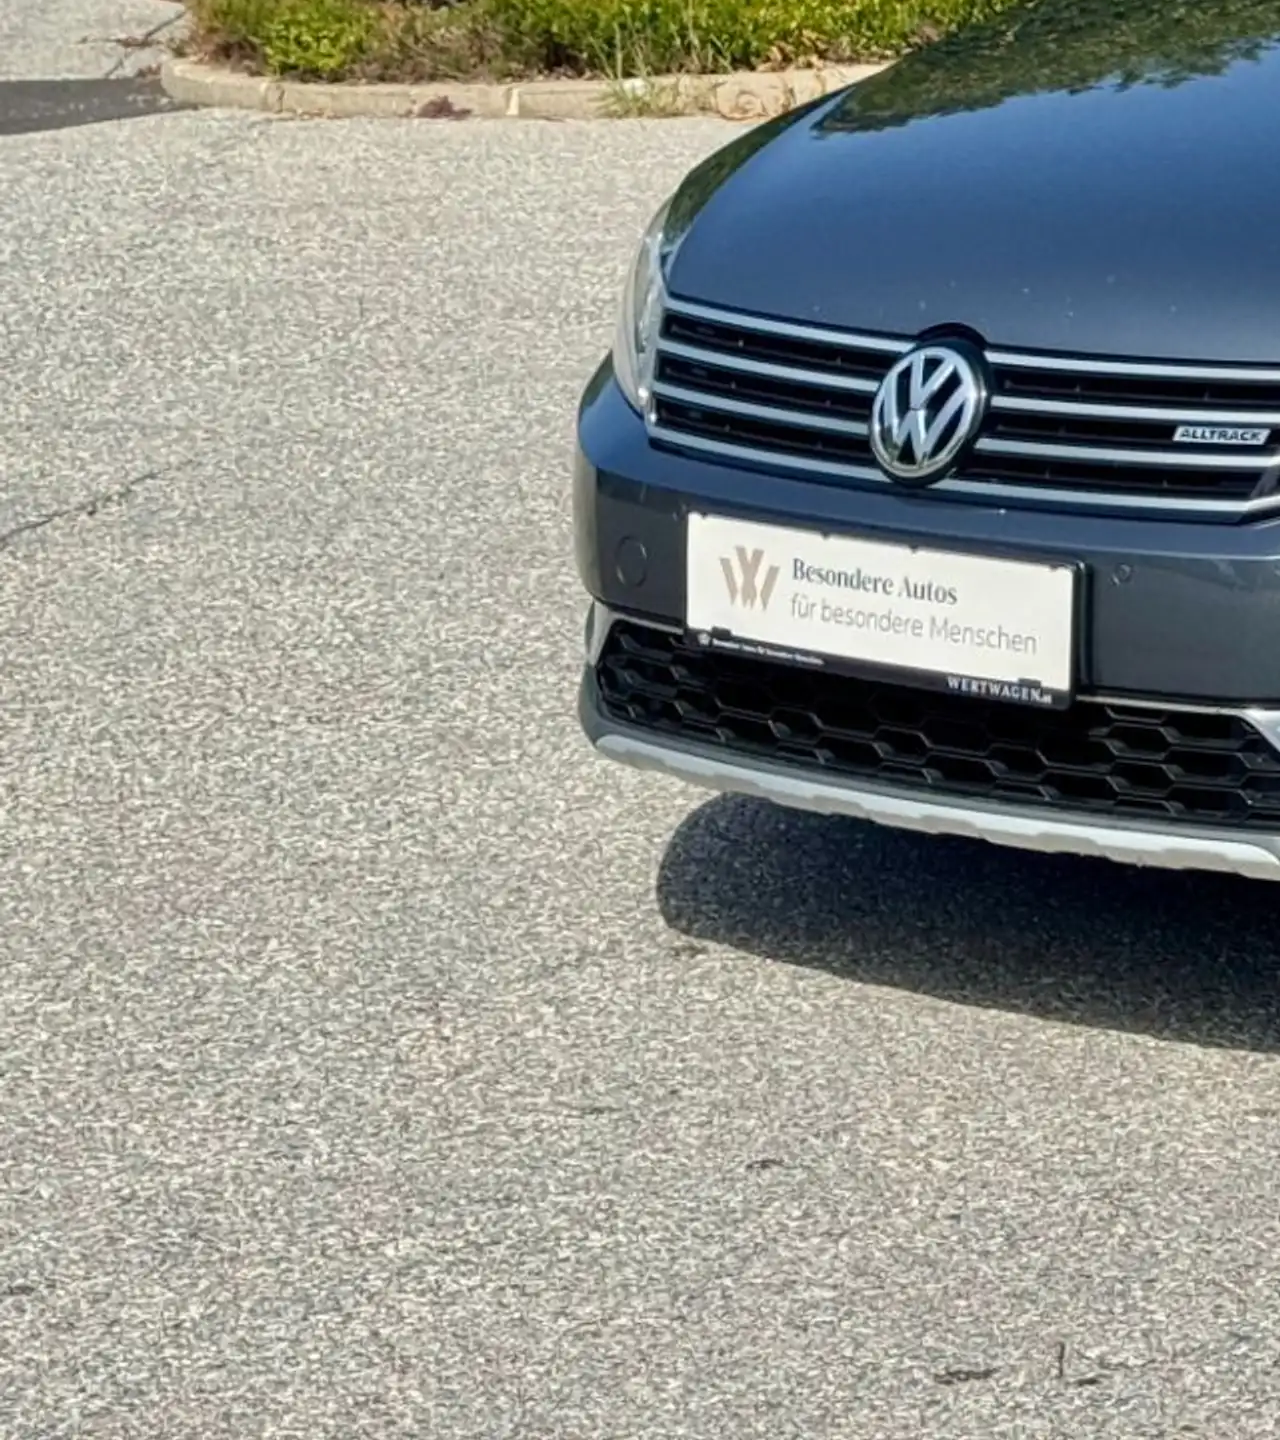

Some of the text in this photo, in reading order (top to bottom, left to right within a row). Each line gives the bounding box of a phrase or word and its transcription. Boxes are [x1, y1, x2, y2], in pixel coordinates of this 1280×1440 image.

[1180, 427, 1261, 441] ALLTRACK
[792, 557, 958, 606] Besondere Autos
[791, 592, 1038, 656] für besondere Menschen
